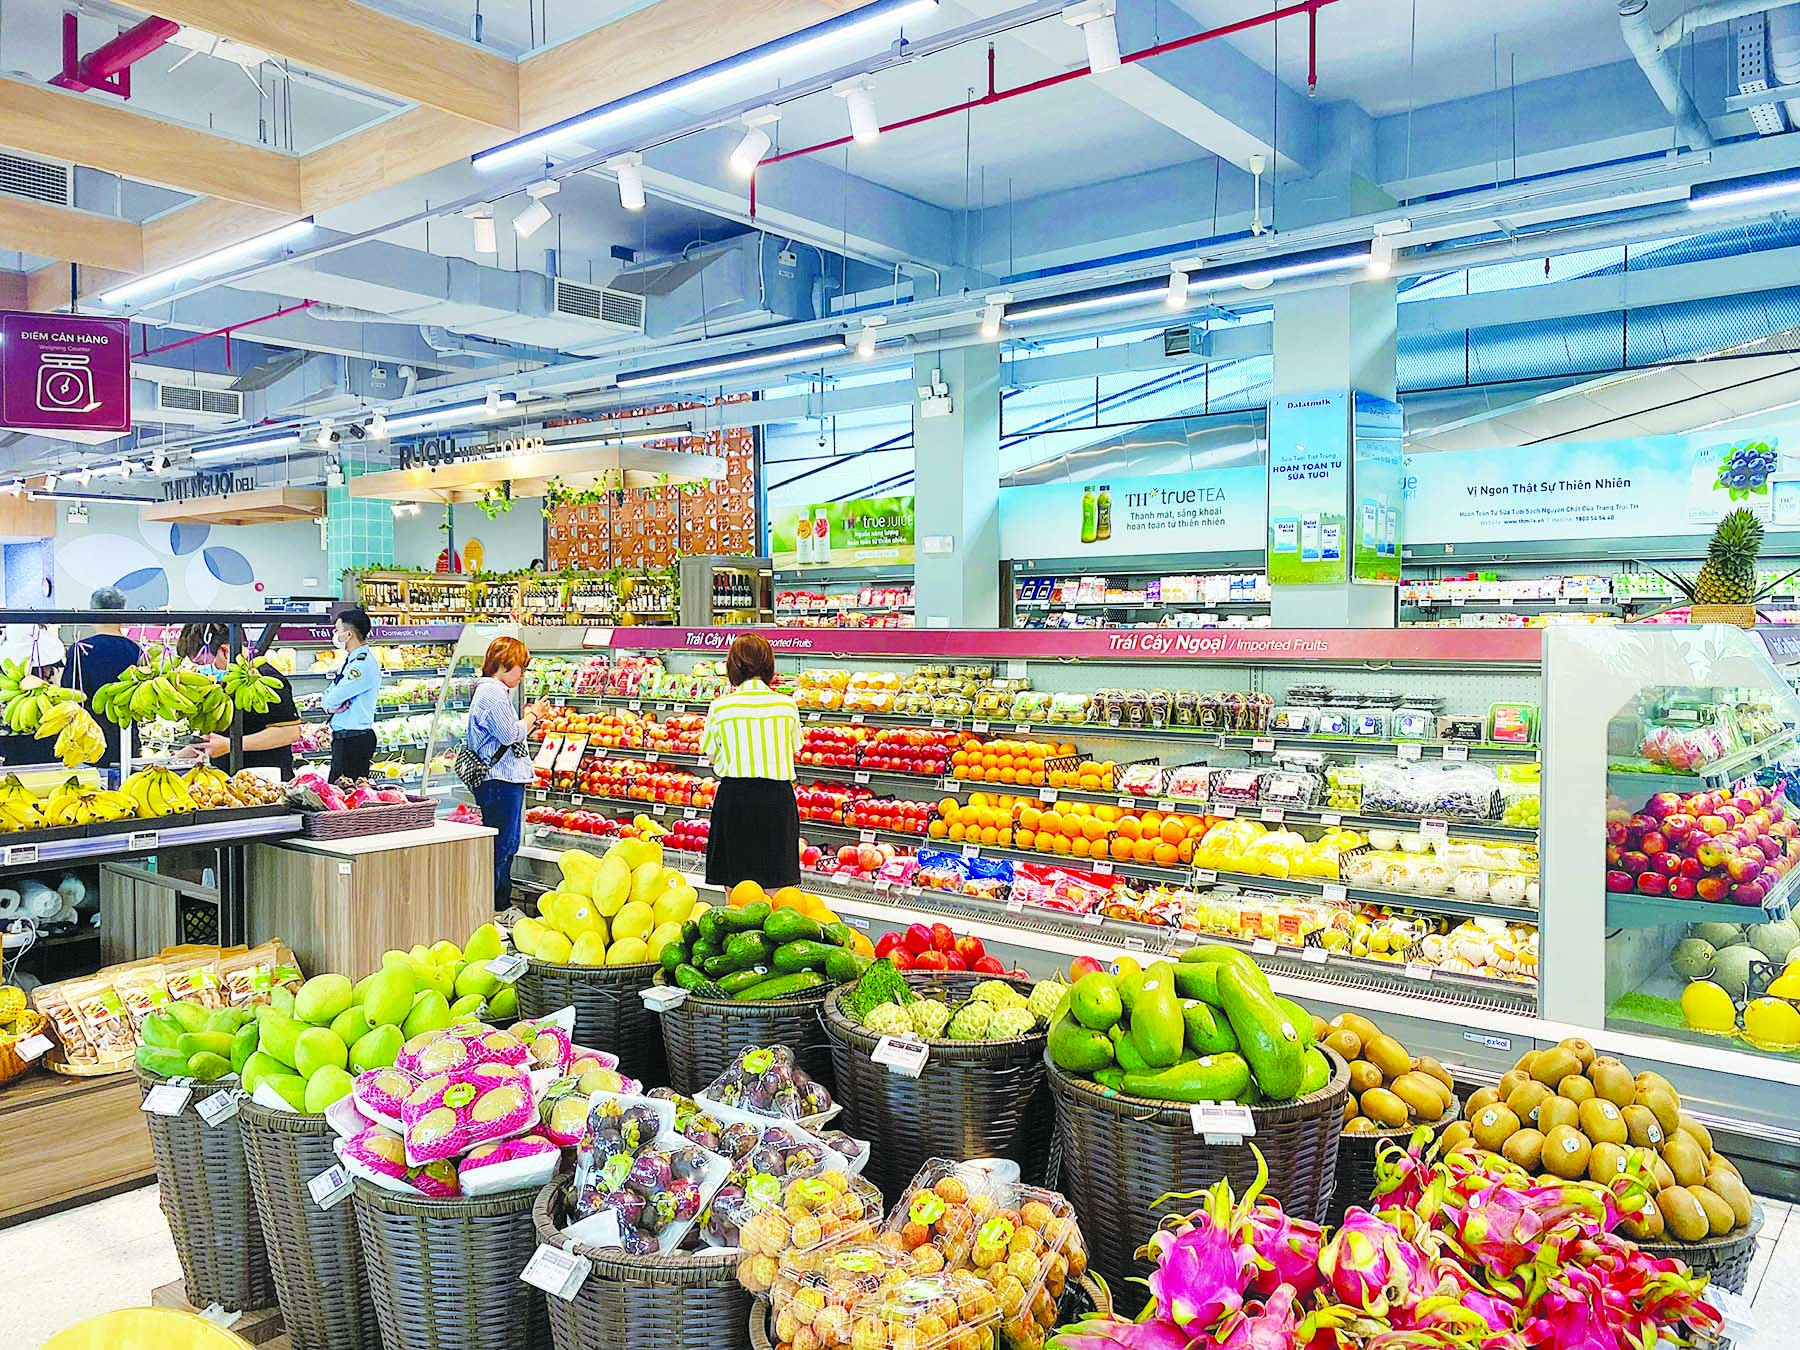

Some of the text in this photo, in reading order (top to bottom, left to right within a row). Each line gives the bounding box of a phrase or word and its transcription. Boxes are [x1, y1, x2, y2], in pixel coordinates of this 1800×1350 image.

[50, 331, 74, 343] CÂN
[76, 332, 109, 345] HÀNG
[39, 344, 66, 352] Weighing
[1466, 477, 1631, 498] Vị Ngon Thật Sự Thiên Nhiên
[1125, 487, 1226, 507] TH true TEA
[863, 515, 886, 528] true
[887, 514, 913, 528] JUICE
[1130, 511, 1155, 520] Thanh
[308, 627, 331, 638] Trái
[381, 629, 413, 637] Domestic
[685, 631, 704, 645] Trái
[704, 633, 725, 648] Cây
[792, 638, 813, 648] Fruits
[1109, 633, 1140, 651] Trái
[1140, 633, 1173, 653] Cây
[1175, 633, 1228, 654] Ngoại
[1236, 638, 1291, 653] Imported
[1293, 638, 1329, 651] Fruits
